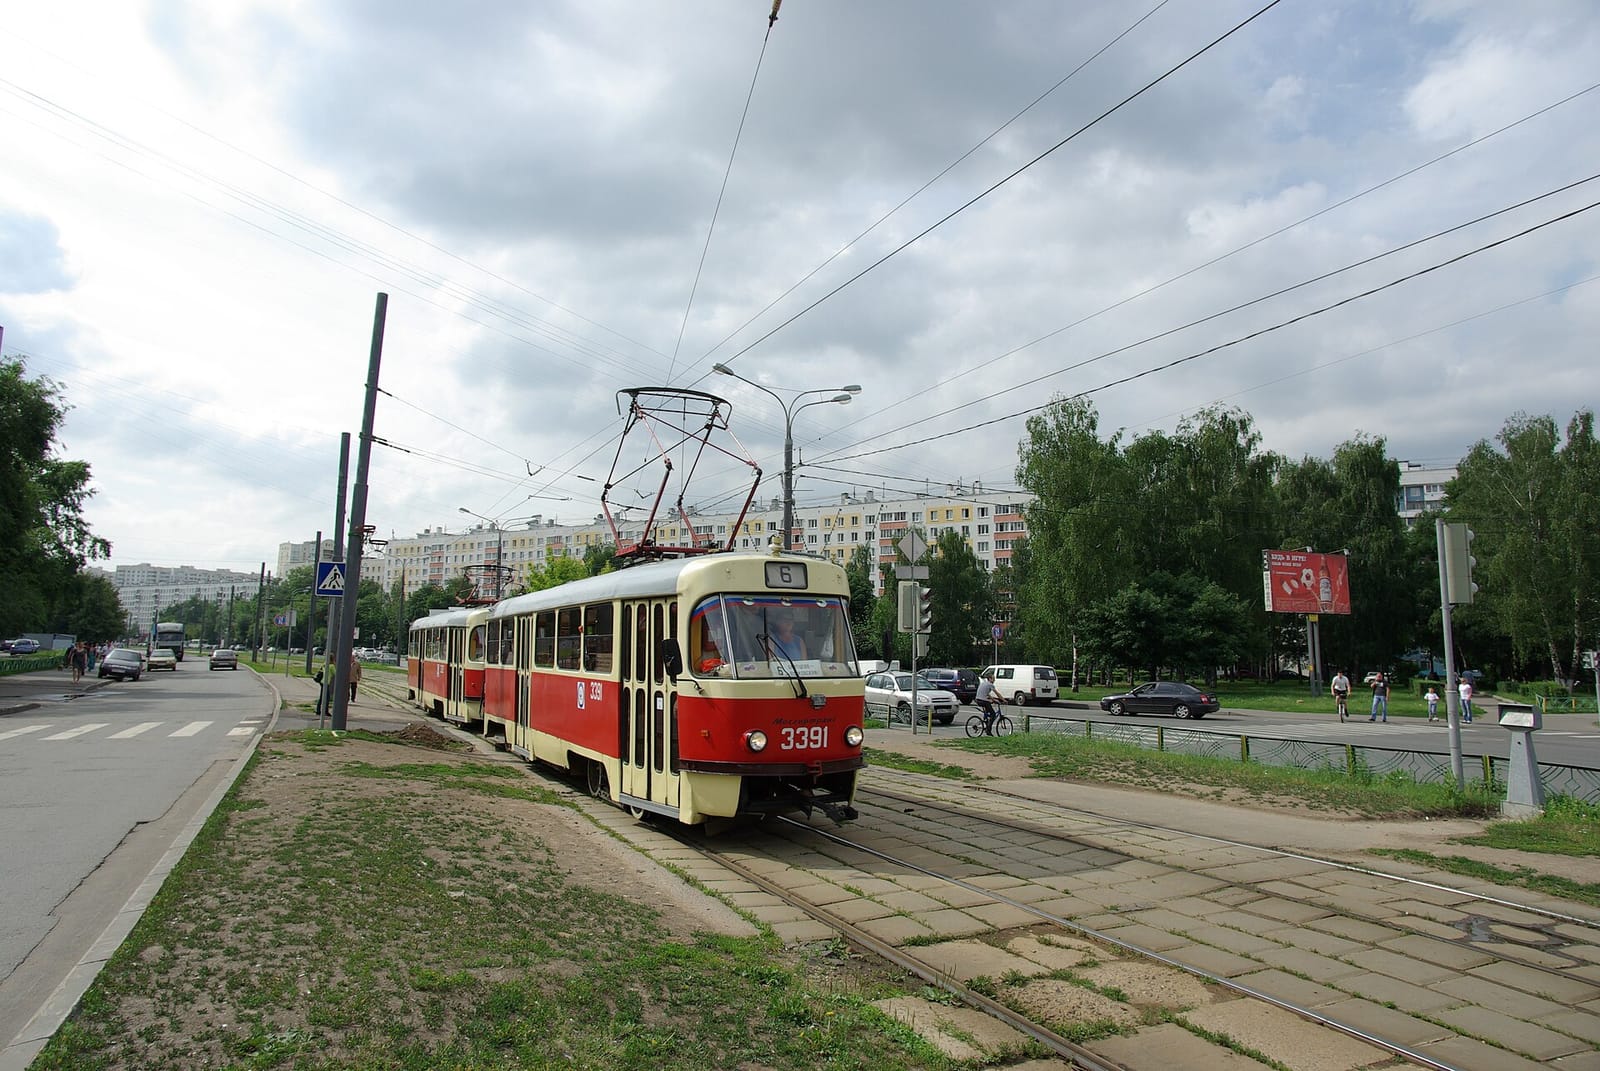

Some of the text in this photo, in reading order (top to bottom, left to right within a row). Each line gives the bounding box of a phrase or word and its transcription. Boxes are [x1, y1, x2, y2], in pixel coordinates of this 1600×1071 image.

[780, 566, 792, 583] 6
[590, 682, 602, 701] 3391
[781, 726, 828, 750] 3391
